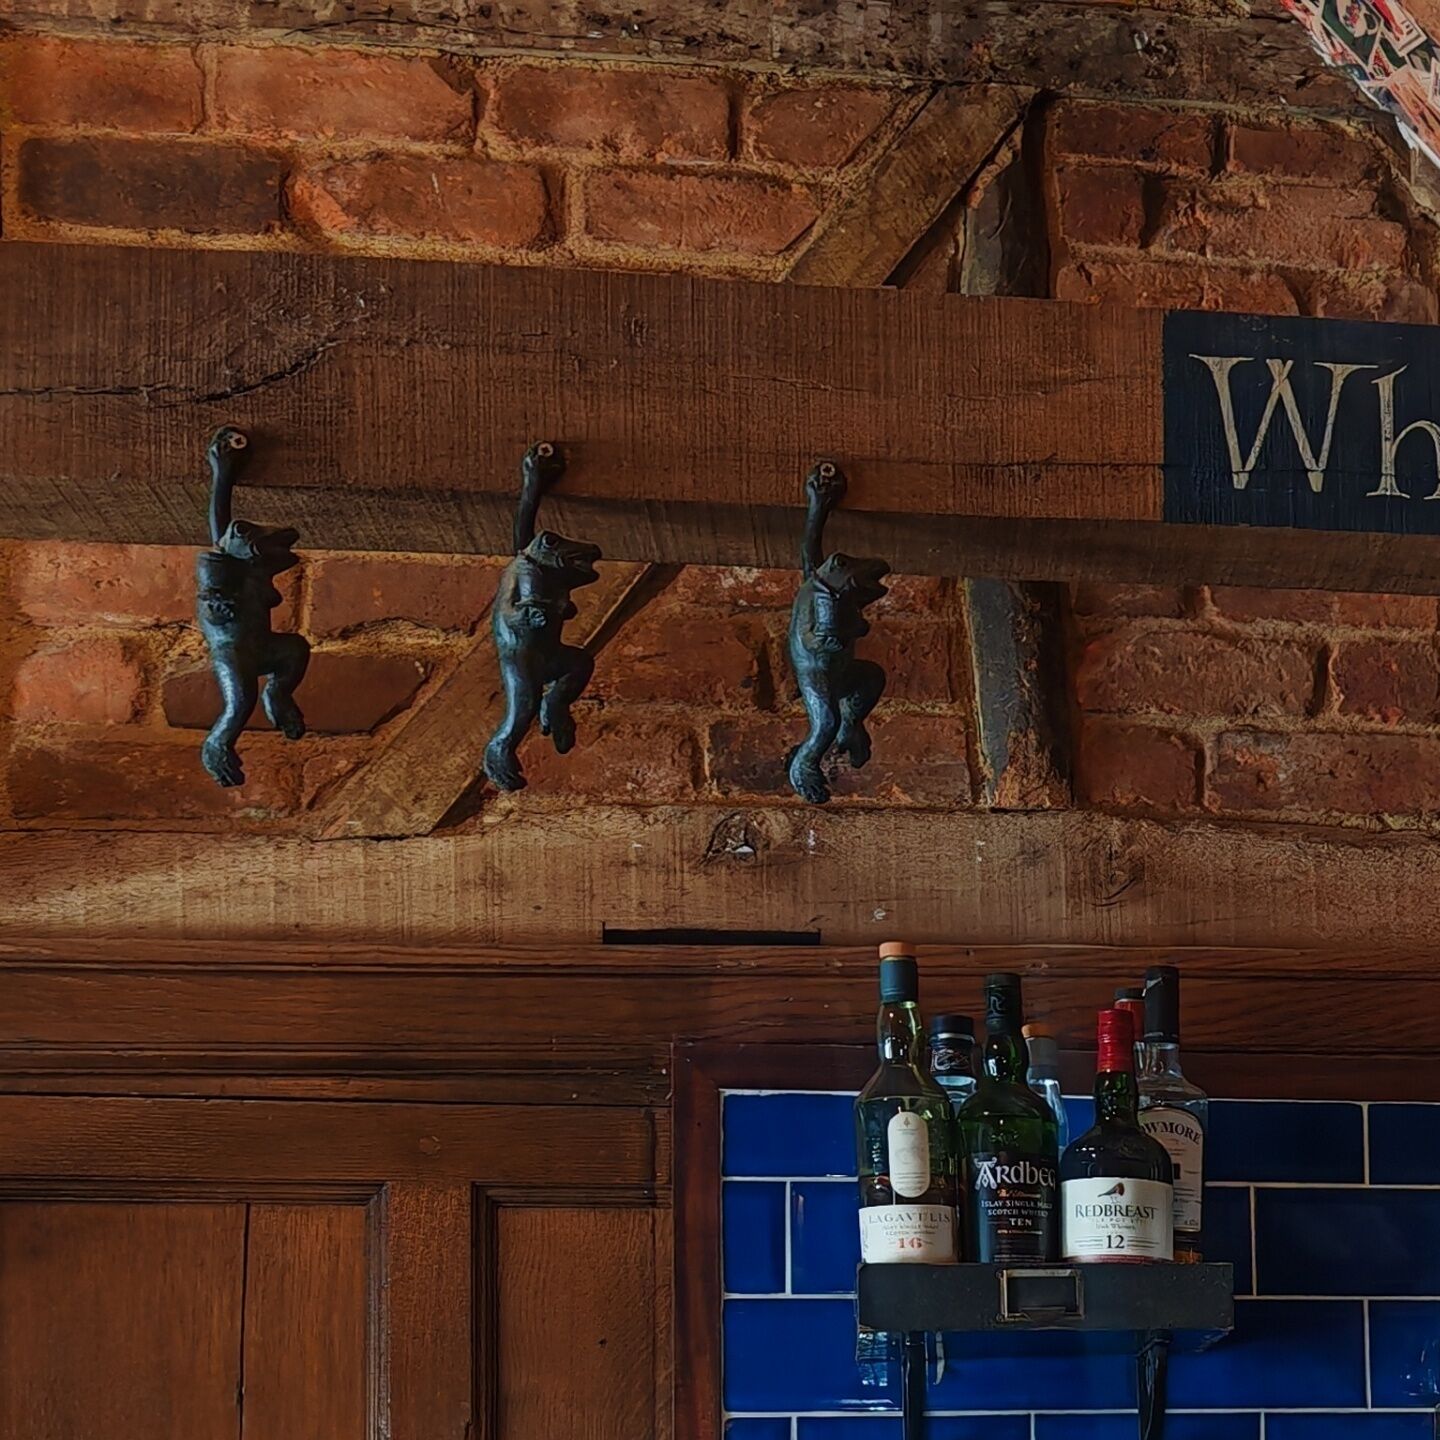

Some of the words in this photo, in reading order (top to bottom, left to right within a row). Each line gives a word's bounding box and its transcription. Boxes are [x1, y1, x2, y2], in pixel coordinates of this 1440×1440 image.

[1142, 1121, 1200, 1145] WMORE
[1075, 1203, 1159, 1220] REDBREAST
[1008, 1217, 1032, 1226] TEN
[897, 1236, 923, 1249] 16
[1106, 1234, 1125, 1249] 12
